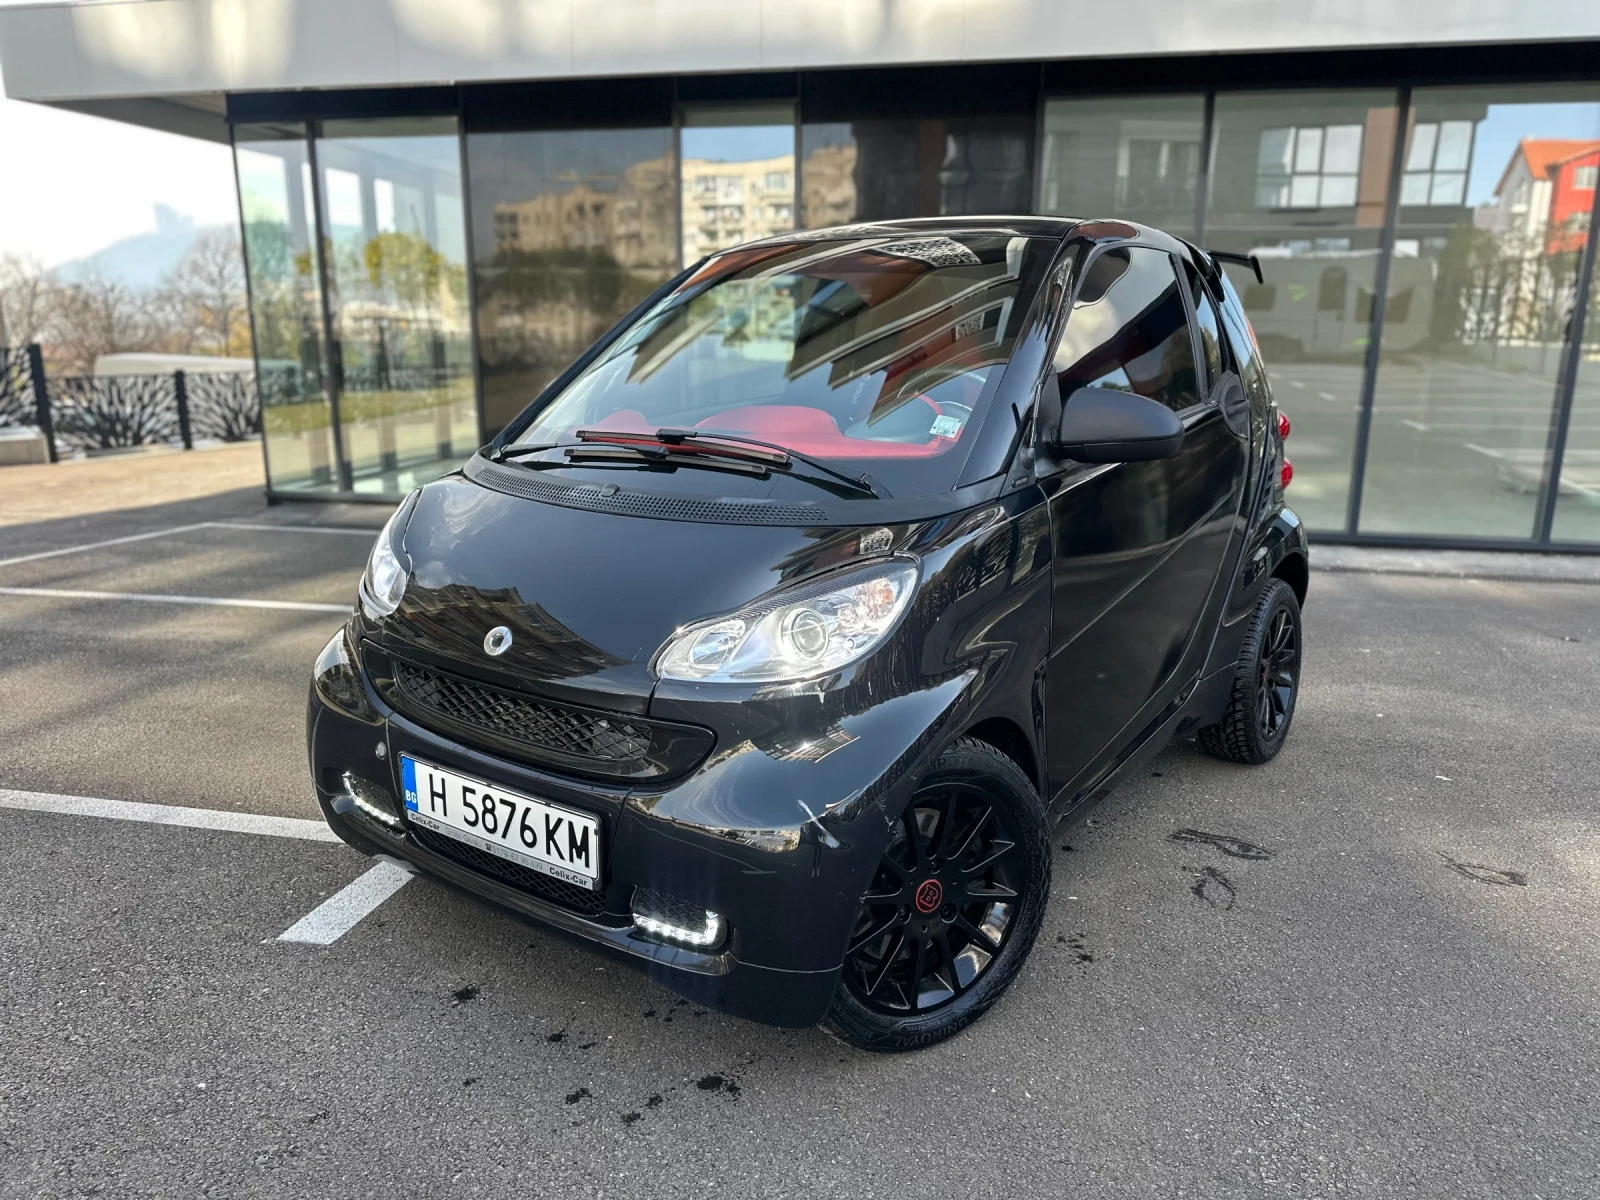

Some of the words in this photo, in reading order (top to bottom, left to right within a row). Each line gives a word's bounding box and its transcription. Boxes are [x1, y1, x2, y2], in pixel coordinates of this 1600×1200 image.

[405, 789, 417, 804] BG
[429, 773, 448, 817] H
[411, 813, 440, 831] Celix-Car
[549, 866, 588, 886] Celix-Car
